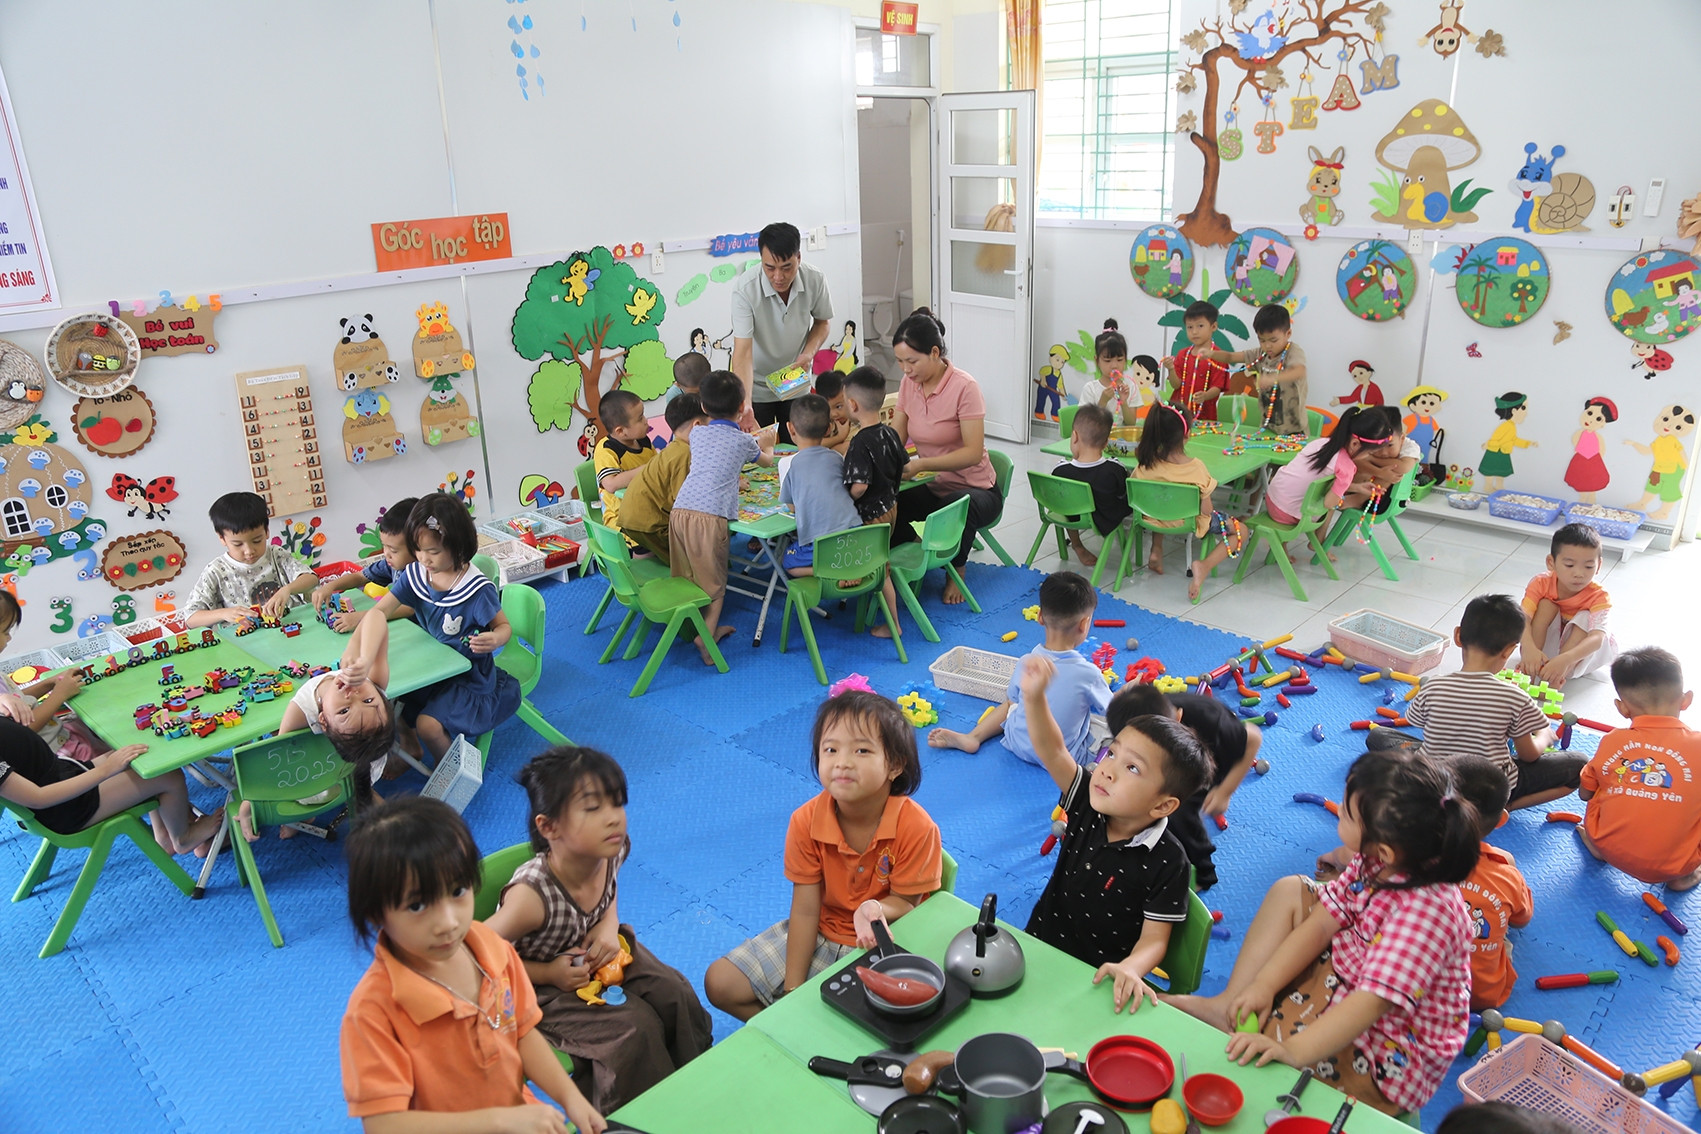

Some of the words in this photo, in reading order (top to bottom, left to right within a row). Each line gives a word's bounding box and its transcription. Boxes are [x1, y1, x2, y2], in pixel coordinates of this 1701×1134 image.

[897, 12, 914, 26] SINH
[15, 242, 28, 255] TIN
[380, 222, 424, 253] Góc
[430, 232, 468, 265] học
[472, 215, 505, 250] tập
[10, 268, 36, 287] SÁNG
[168, 316, 195, 332] vui
[168, 332, 206, 348] toán
[830, 543, 873, 569] 2025
[277, 751, 337, 788] 2025
